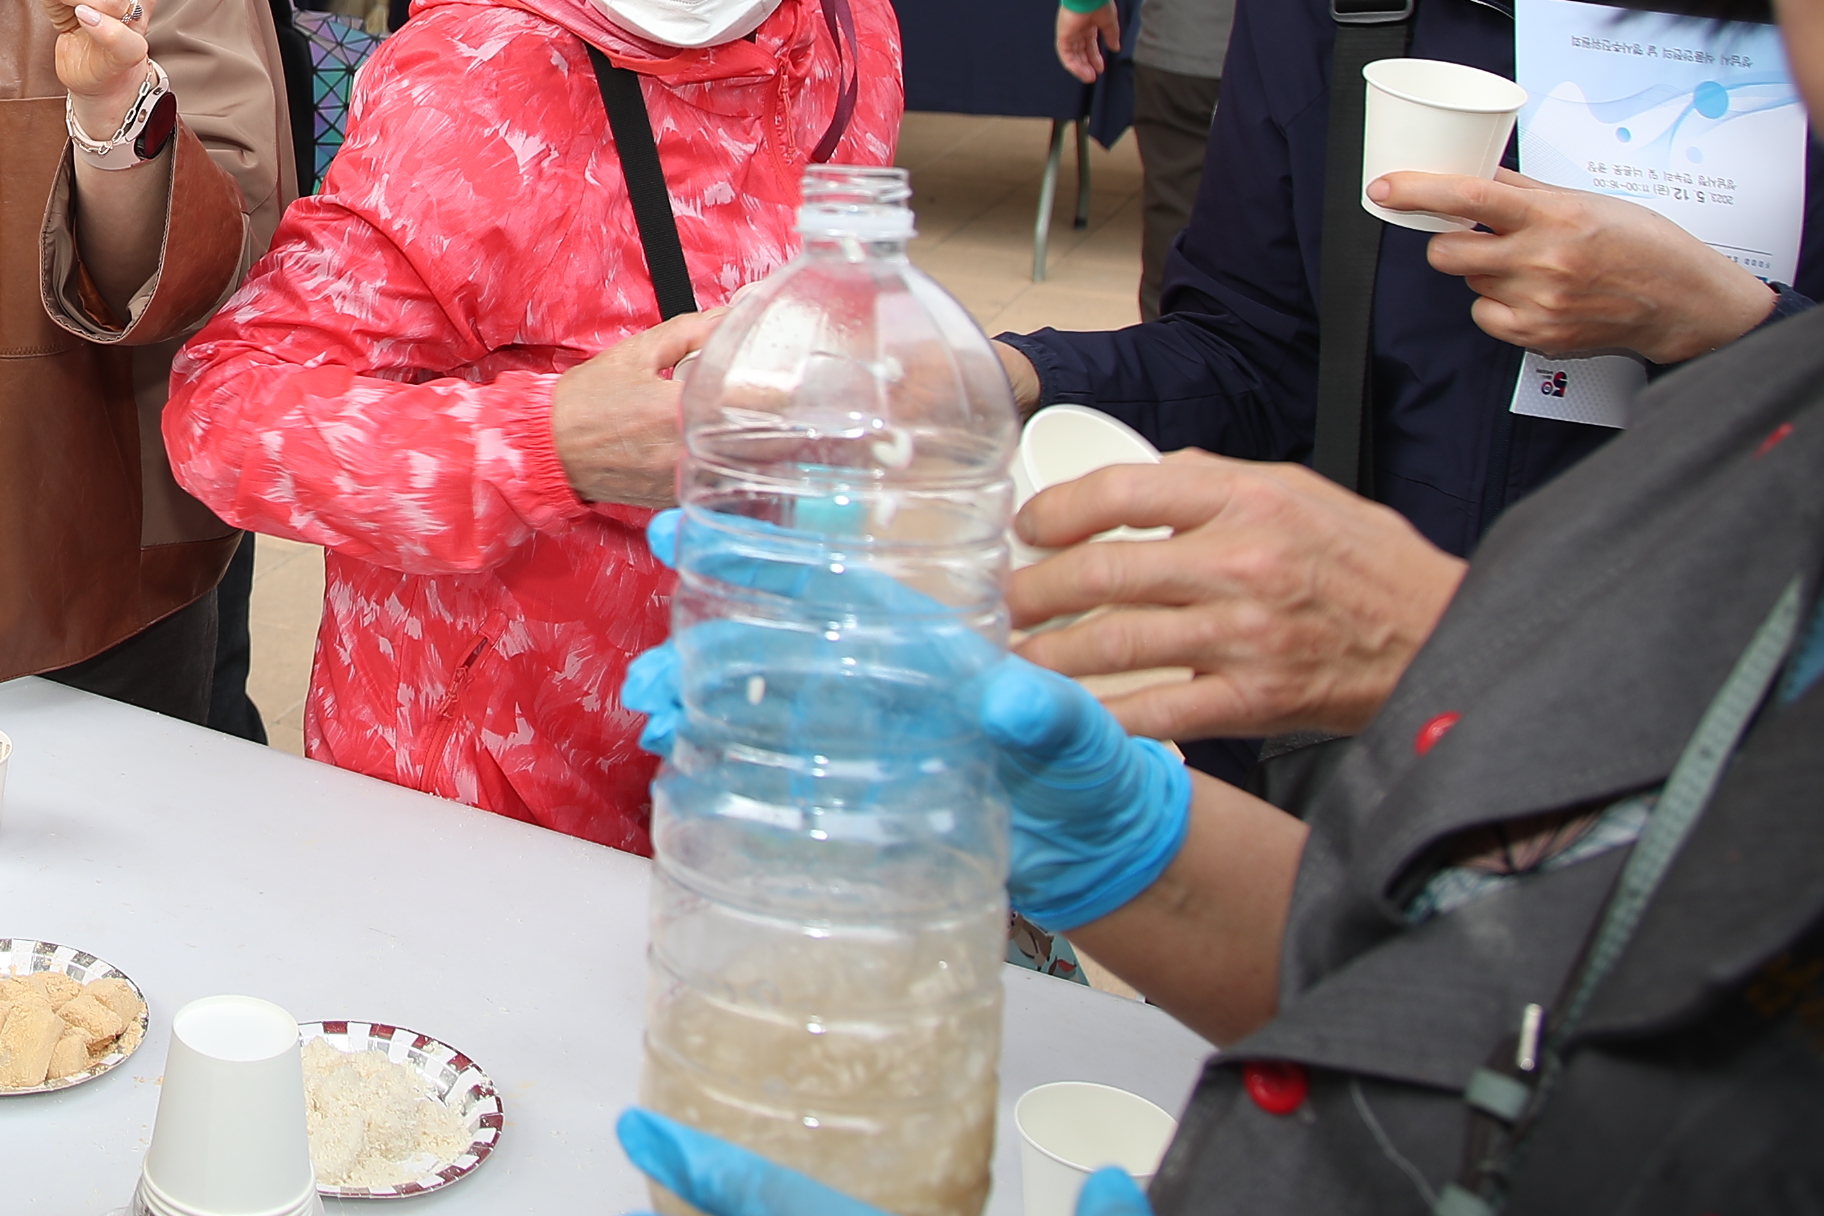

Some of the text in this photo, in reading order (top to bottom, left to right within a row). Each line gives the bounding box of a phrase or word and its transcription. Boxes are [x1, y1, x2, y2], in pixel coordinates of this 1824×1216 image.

[1570, 34, 1644, 55] 행사추진위원회
[1646, 44, 1658, 58] 날
[1662, 46, 1716, 64] 식품안전의
[1587, 161, 1607, 174] 광장
[1663, 170, 1693, 185] 한누리
[1697, 175, 1738, 191] 성남시청
